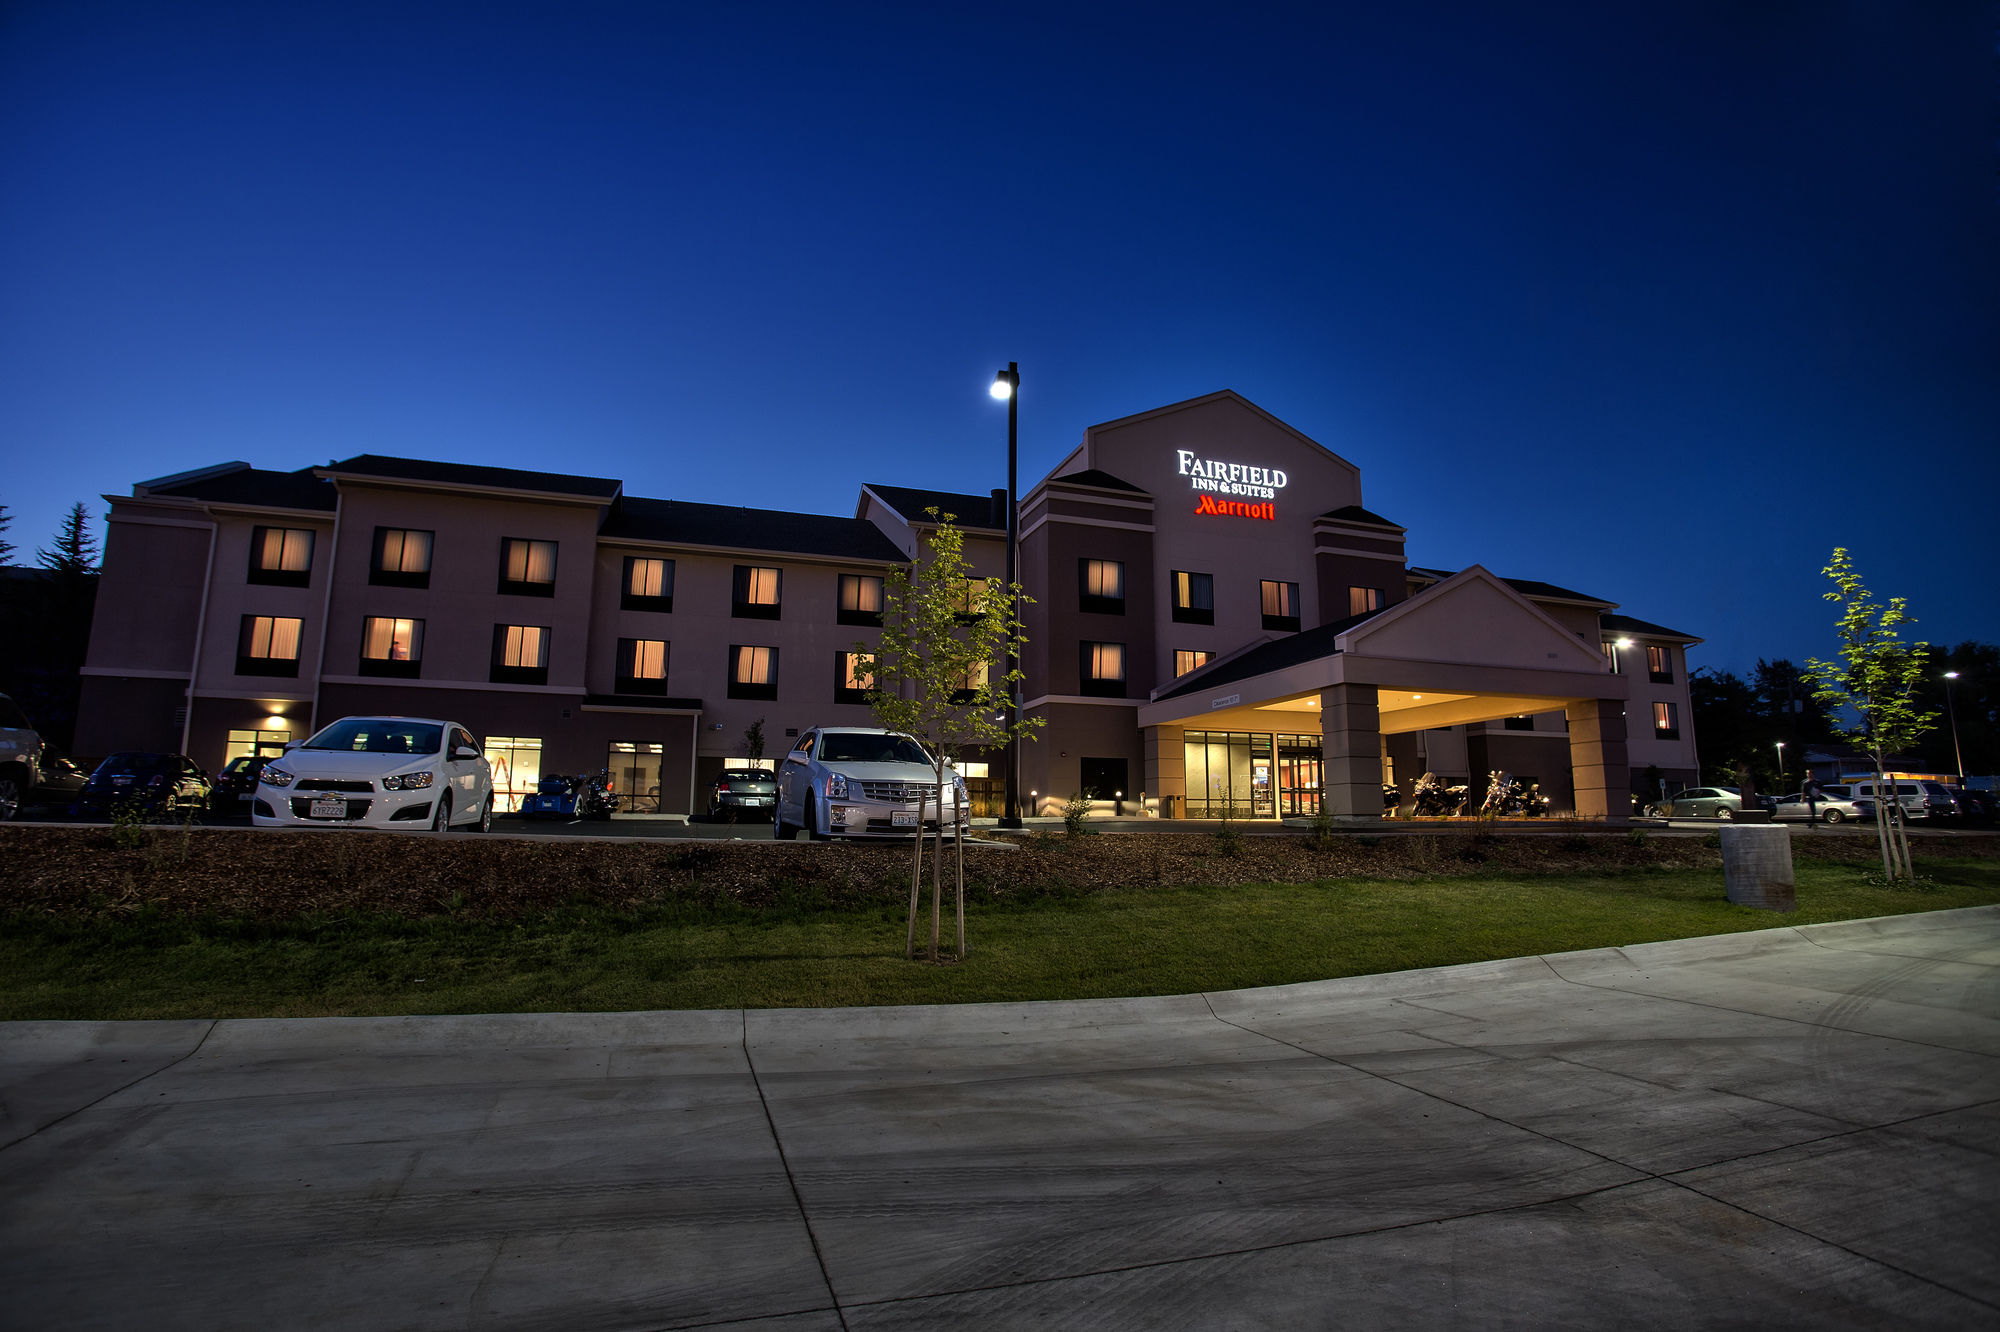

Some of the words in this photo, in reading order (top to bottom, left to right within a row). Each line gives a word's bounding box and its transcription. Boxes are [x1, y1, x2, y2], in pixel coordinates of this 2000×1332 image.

[1177, 450, 1287, 488] FAIRFIELD
[1191, 477, 1218, 492] INN
[1219, 482, 1231, 493] &
[1231, 484, 1275, 499] SUITES
[1195, 494, 1275, 520] Marriott
